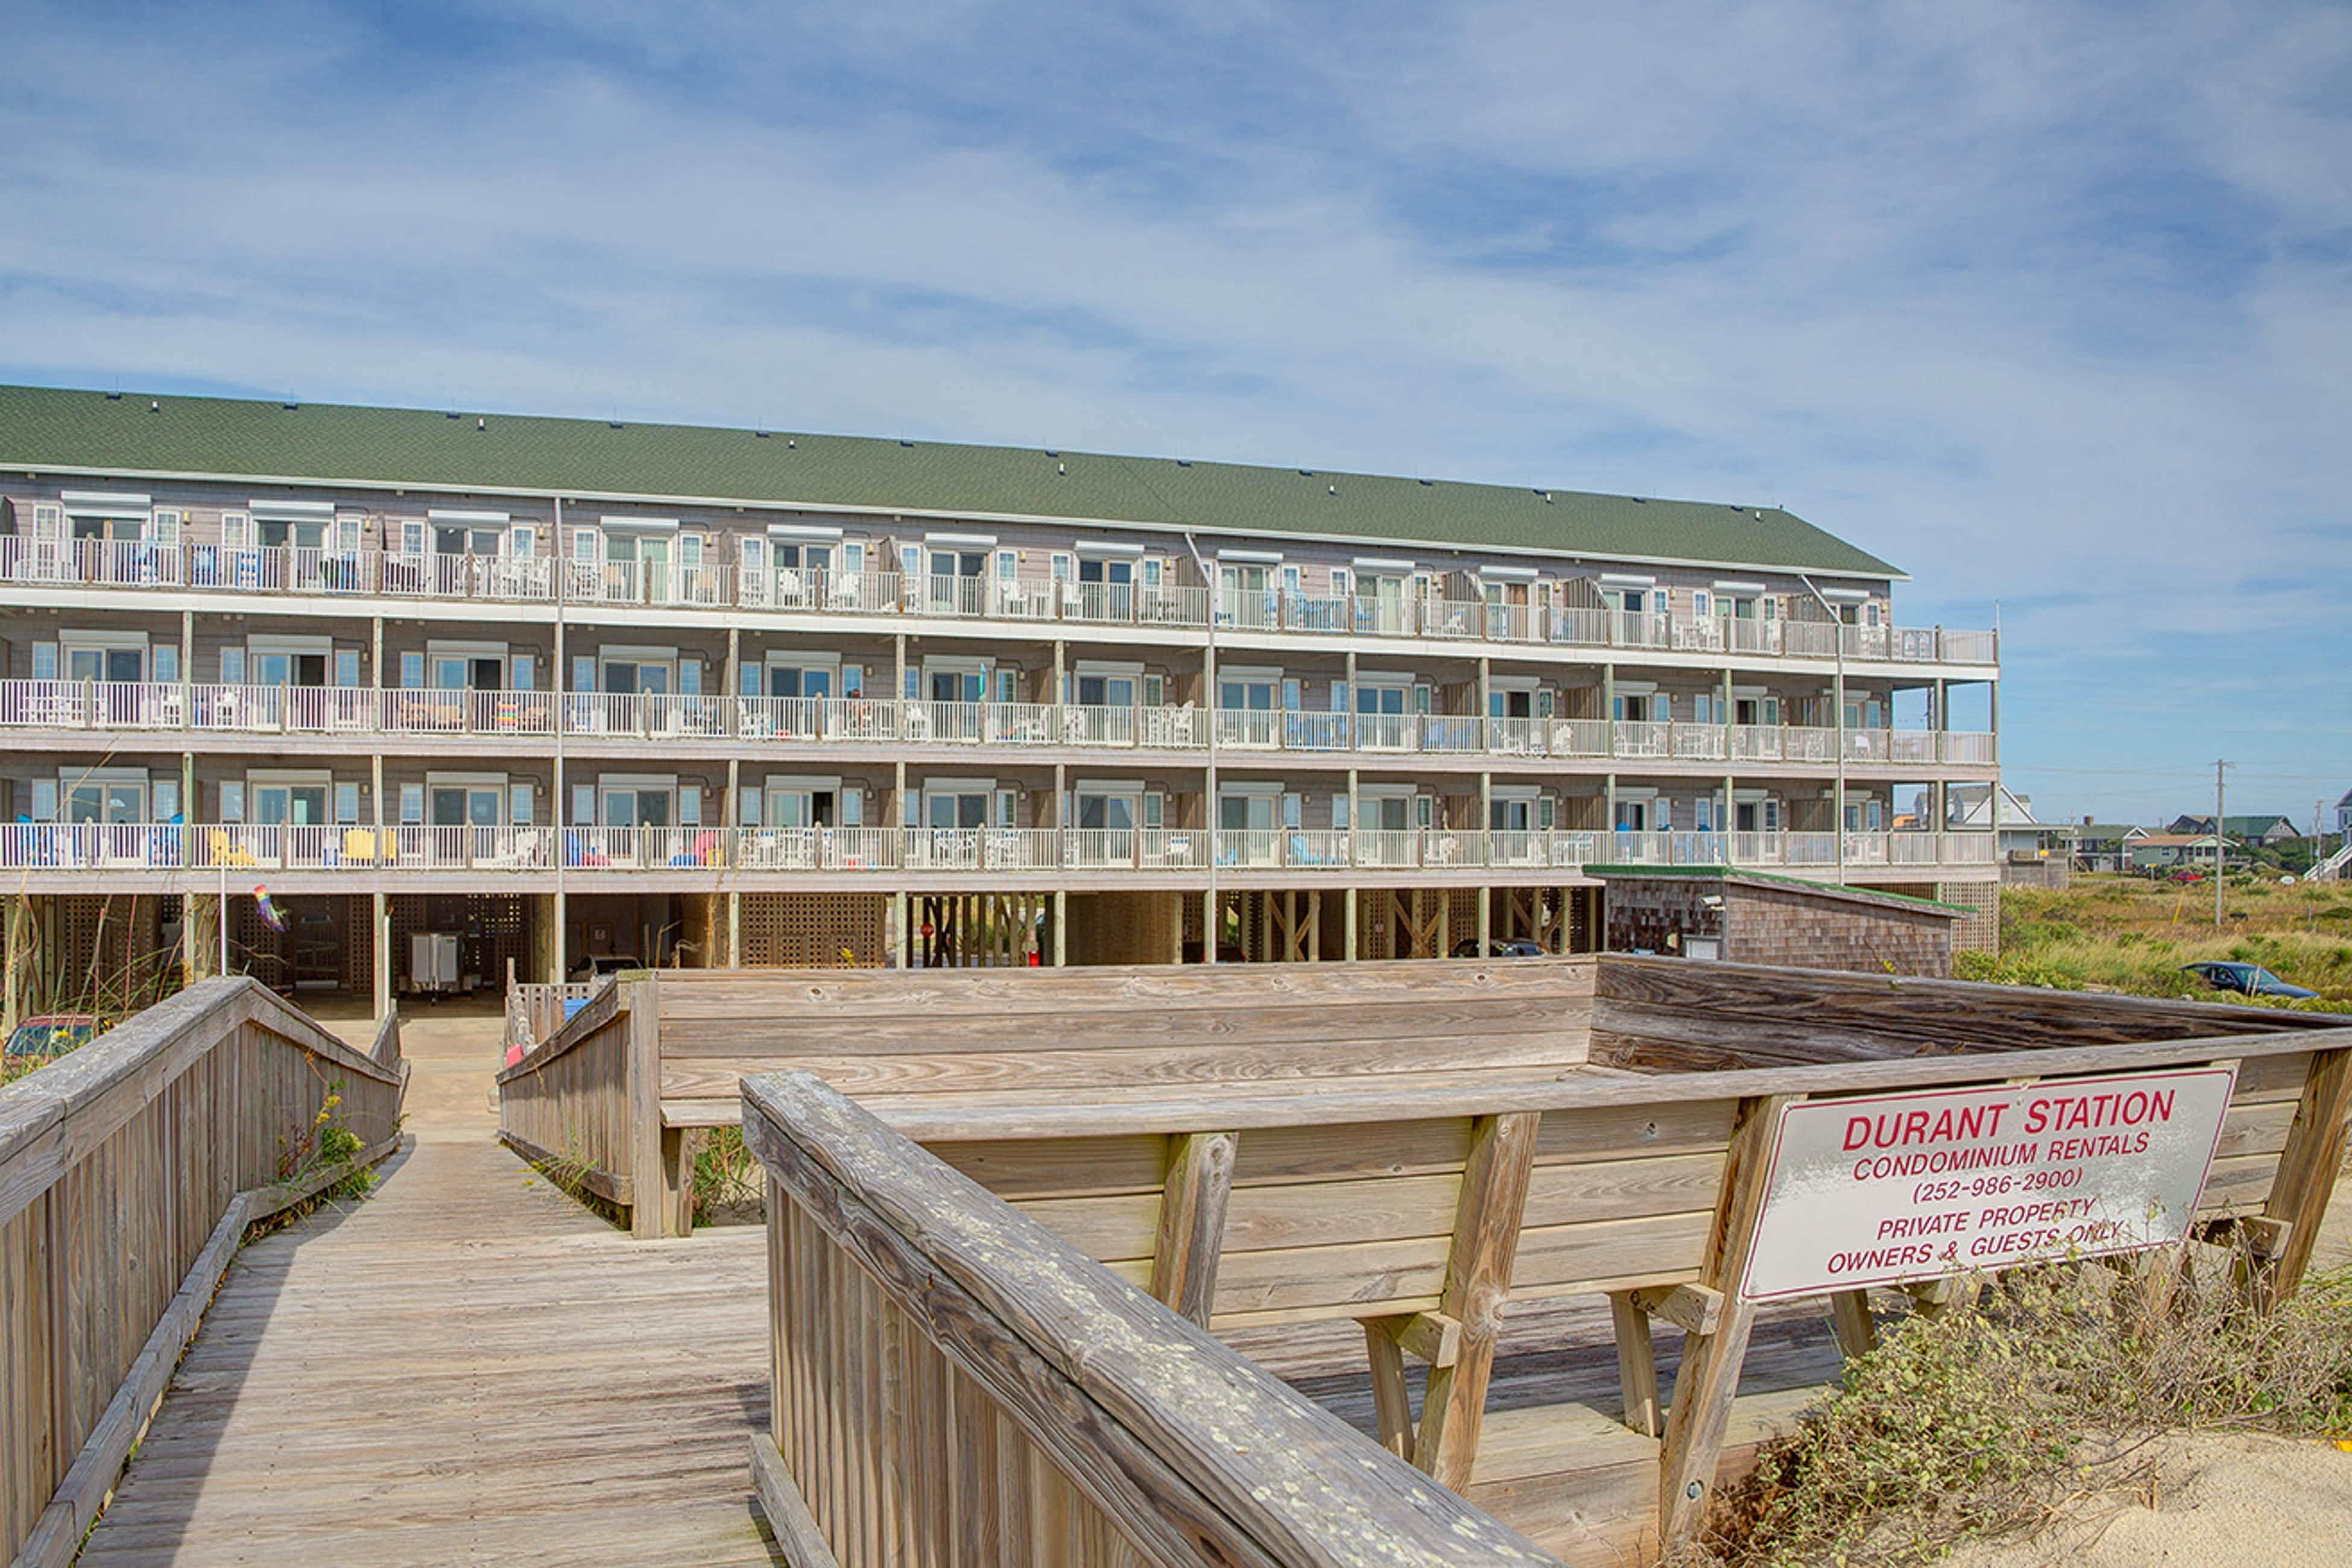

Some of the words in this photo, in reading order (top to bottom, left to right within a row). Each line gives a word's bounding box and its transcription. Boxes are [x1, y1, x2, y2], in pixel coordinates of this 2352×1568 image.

[1843, 1103, 2010, 1151] DURANT
[2024, 1089, 2175, 1134] STATION
[1853, 1142, 2038, 1181] CONDOMINIUM
[2047, 1131, 2150, 1162] RENTALS
[1912, 1168, 2083, 1204] (252-986-2900)
[1877, 1211, 1971, 1241] PRIVATE
[1979, 1197, 2097, 1229] PROPERTY
[1827, 1243, 1933, 1274] OWNERS
[1943, 1240, 1958, 1260] &
[1970, 1228, 2060, 1257] GUESTS
